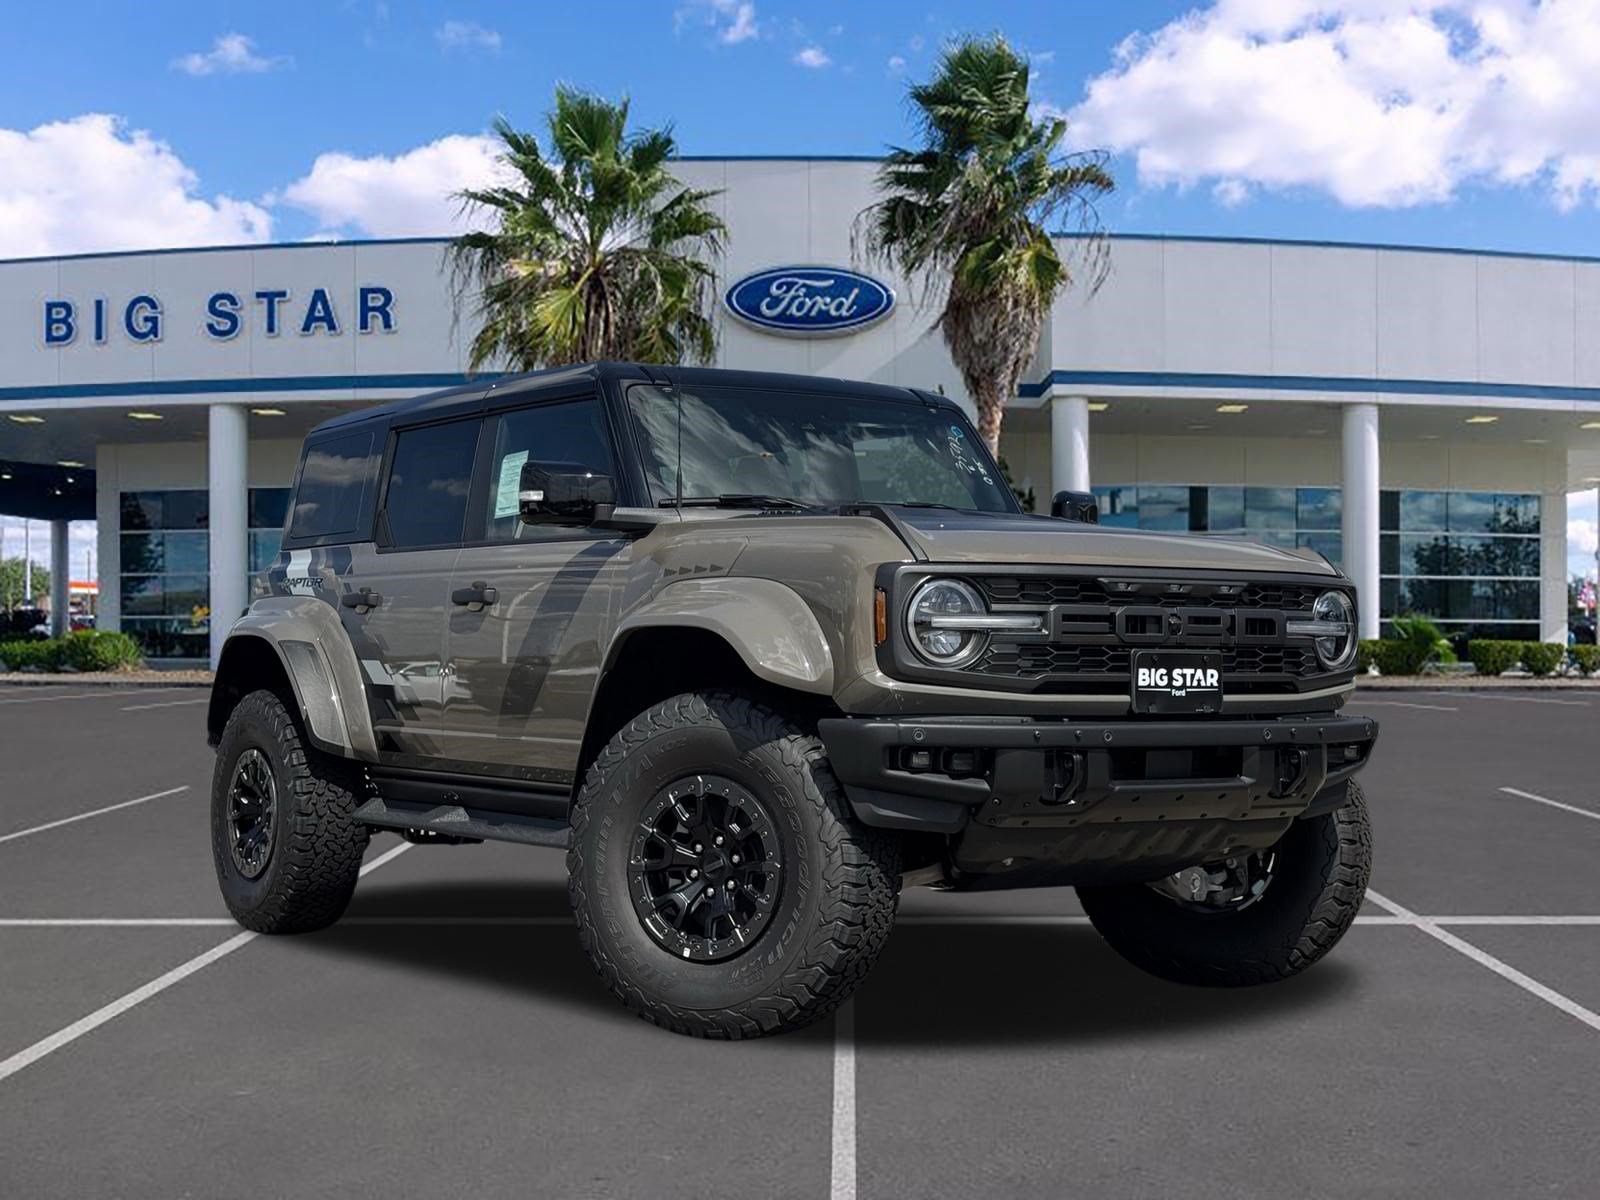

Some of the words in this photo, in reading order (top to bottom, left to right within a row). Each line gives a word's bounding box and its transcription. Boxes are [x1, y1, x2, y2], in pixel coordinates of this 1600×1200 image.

[759, 277, 860, 318] Ford
[43, 294, 164, 346] BIG
[205, 286, 398, 341] STAR
[281, 577, 324, 591] RAPTOR
[1050, 604, 1287, 645] FORD
[1137, 667, 1169, 687] BIG
[1172, 667, 1219, 687] STAR
[1171, 688, 1187, 697] Ford
